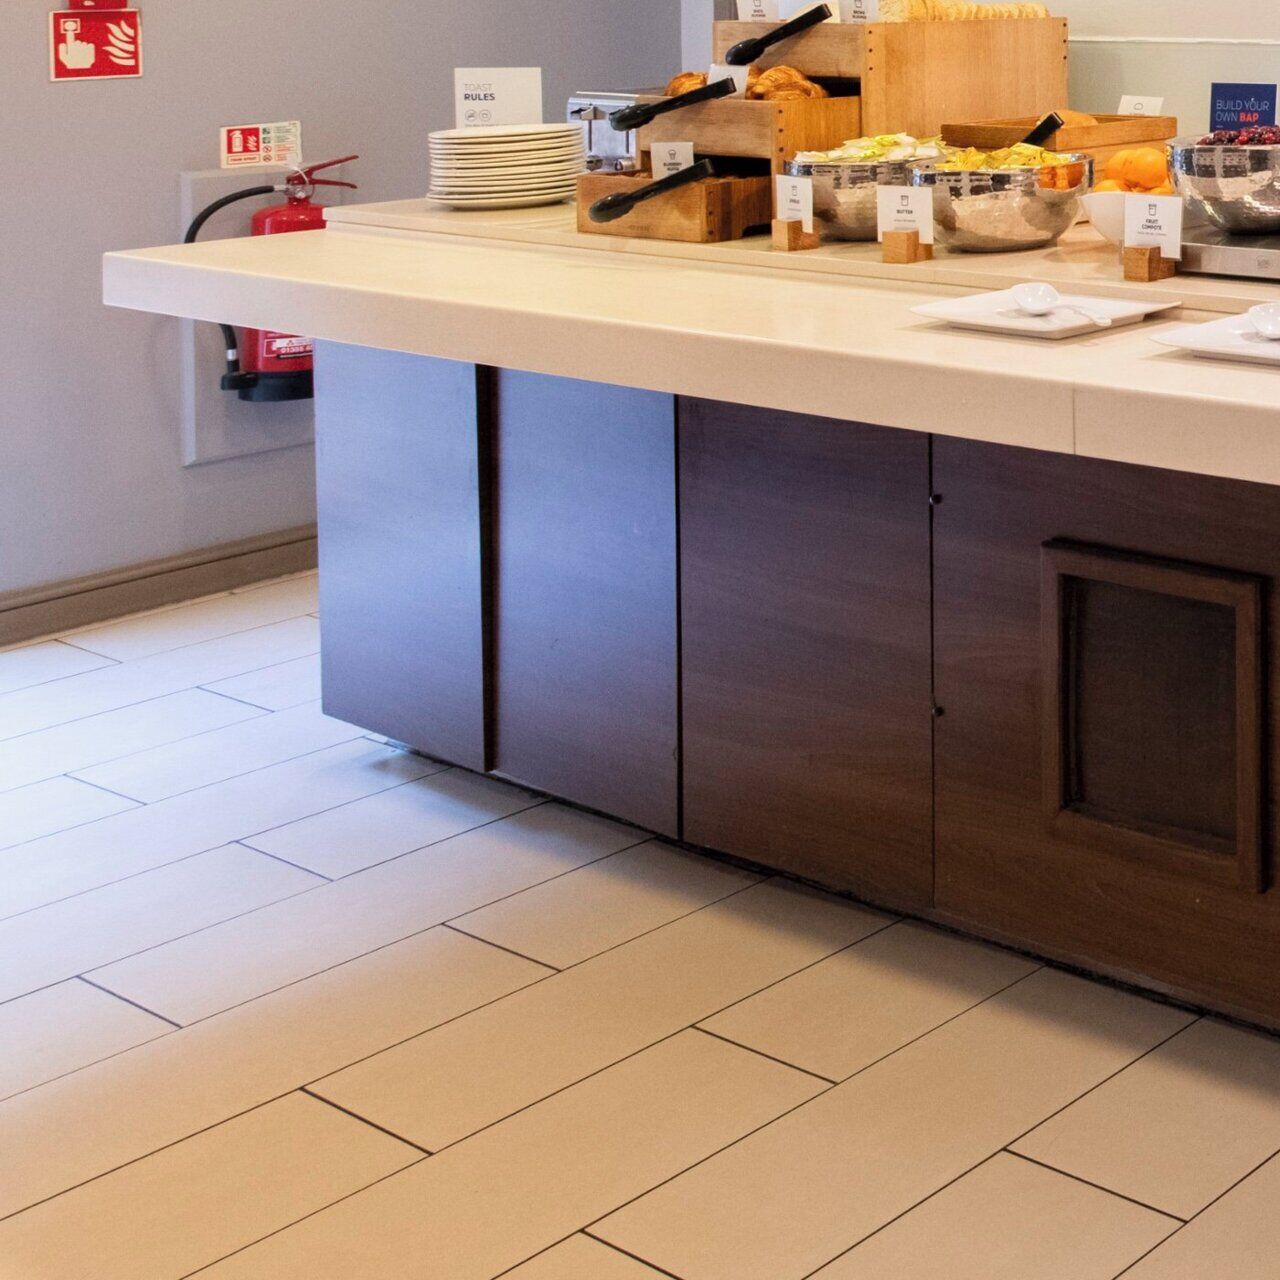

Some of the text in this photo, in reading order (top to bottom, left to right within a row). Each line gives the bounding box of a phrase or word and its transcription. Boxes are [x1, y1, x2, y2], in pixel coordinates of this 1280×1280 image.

[464, 93, 495, 101] RULES
[1216, 99, 1270, 111] BUILD YOUR
[1216, 111, 1259, 122] OWN BAP
